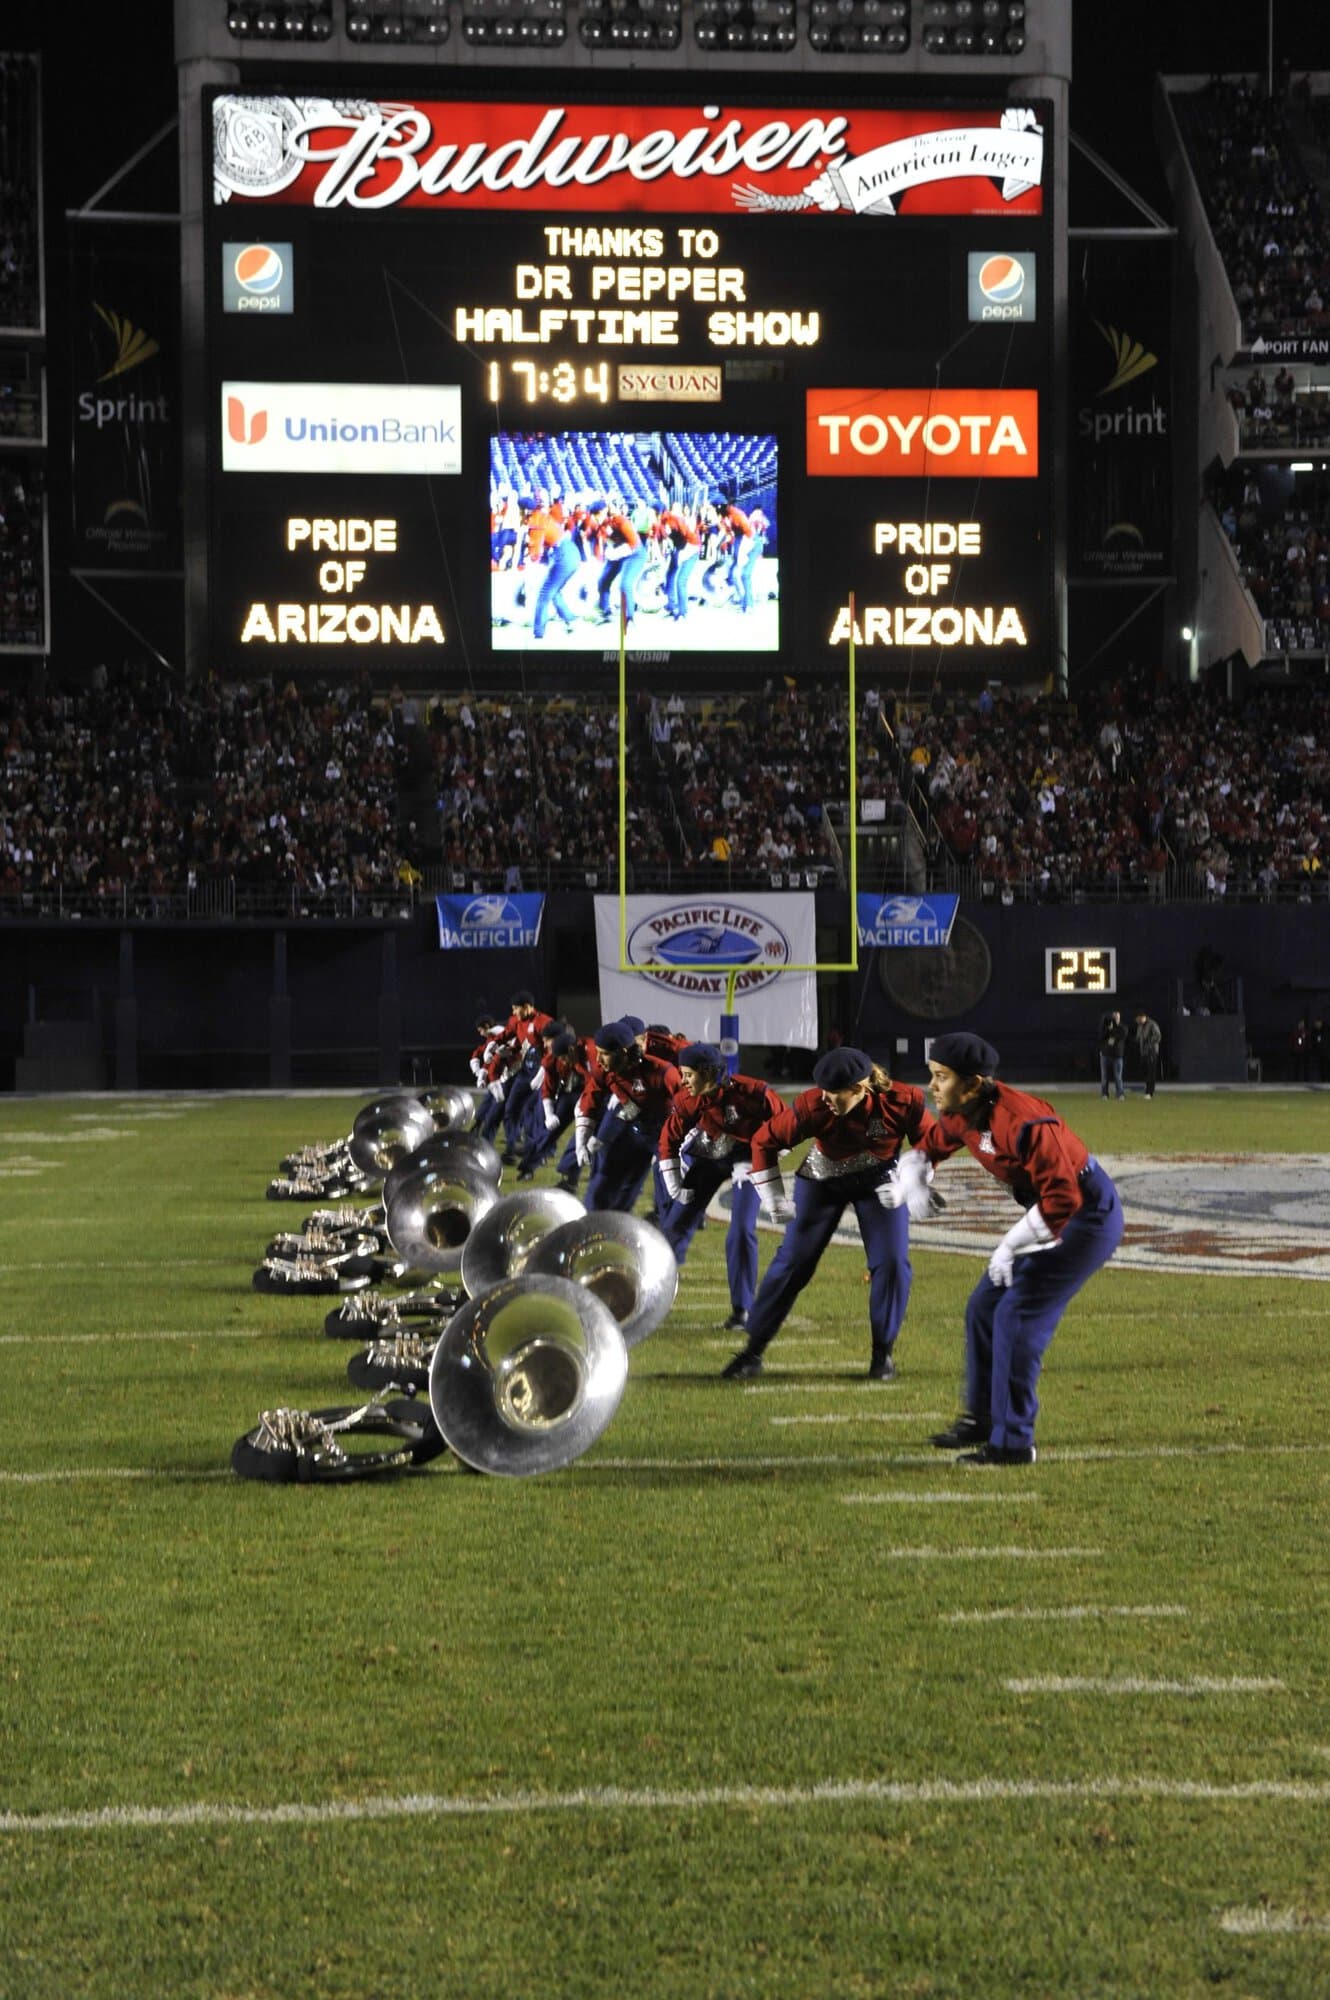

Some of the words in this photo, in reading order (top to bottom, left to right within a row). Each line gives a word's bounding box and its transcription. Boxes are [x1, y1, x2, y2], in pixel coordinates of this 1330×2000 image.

[287, 105, 848, 208] Budweiser
[857, 149, 961, 197] American
[969, 144, 1036, 168] Lager
[544, 227, 664, 258] THANKS
[678, 229, 720, 259] TO
[516, 265, 574, 300] DR
[592, 266, 746, 302] PEPPER
[237, 294, 281, 311] pepsi
[981, 303, 1024, 320] pepsi
[455, 308, 680, 345] HALFTIME
[708, 311, 821, 346] SHOW
[1260, 340, 1299, 355] PORT
[489, 361, 609, 403] 17:34
[621, 375, 720, 392] SYCUAN
[78, 392, 169, 429] Sprint
[1078, 405, 1167, 443] Sprint
[285, 416, 457, 445] UnionBank
[818, 414, 1028, 456] TOYOTA
[287, 518, 397, 552] PRIDE
[874, 522, 982, 556] PRIDE
[319, 560, 367, 593] OF
[904, 564, 951, 597] OF
[240, 603, 446, 645] ARIZONA
[828, 607, 1028, 646] ARIZONA
[440, 927, 506, 949] PACIFIC
[509, 927, 536, 947] LIF
[648, 909, 721, 937] PACIFIC
[723, 908, 765, 937] LIFE
[923, 926, 948, 946] LIF
[1058, 951, 1105, 990] 25
